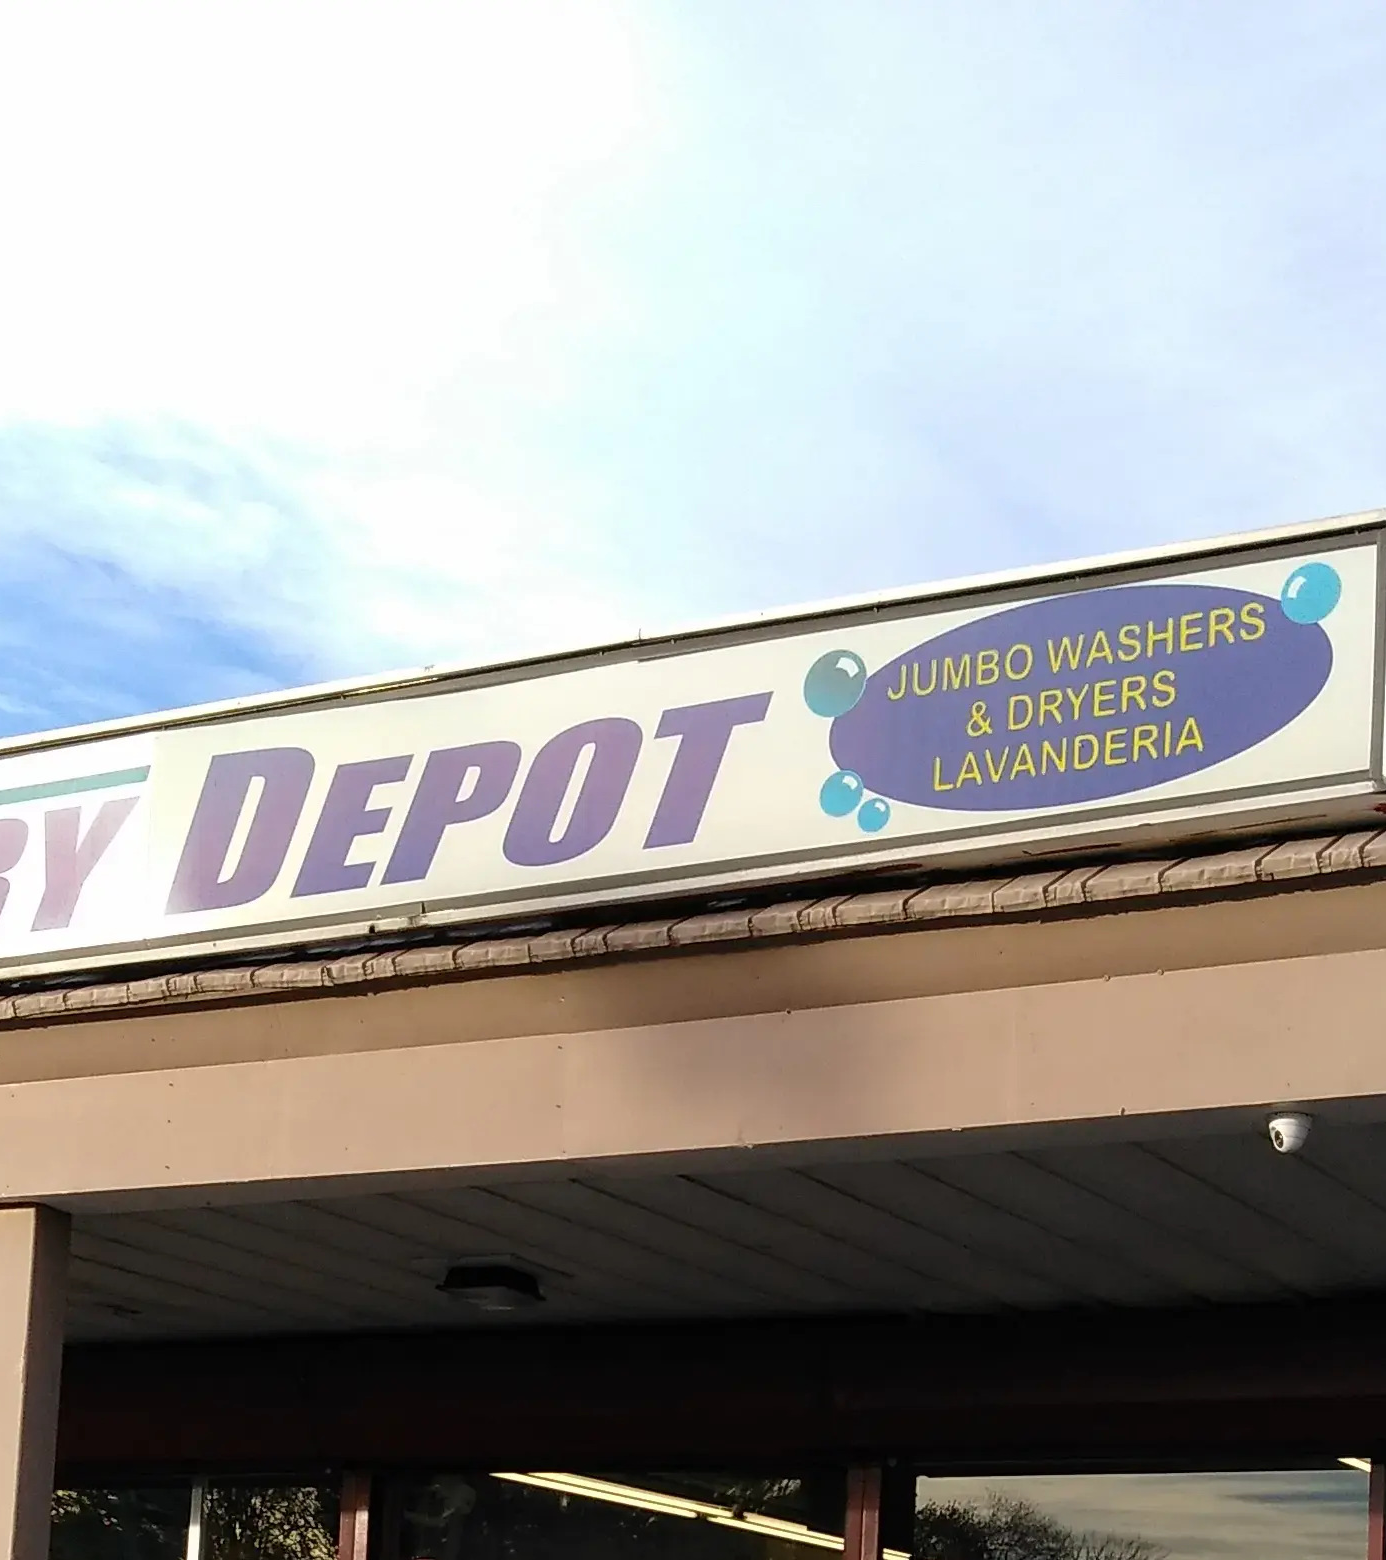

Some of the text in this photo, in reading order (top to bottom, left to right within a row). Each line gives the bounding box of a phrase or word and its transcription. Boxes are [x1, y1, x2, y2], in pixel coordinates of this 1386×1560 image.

[887, 601, 1267, 701] JUMBO WASHERS
[966, 669, 1177, 738] & DRYERS
[933, 716, 1205, 792] LAVANDERIA
[165, 690, 773, 915] DEPOT
